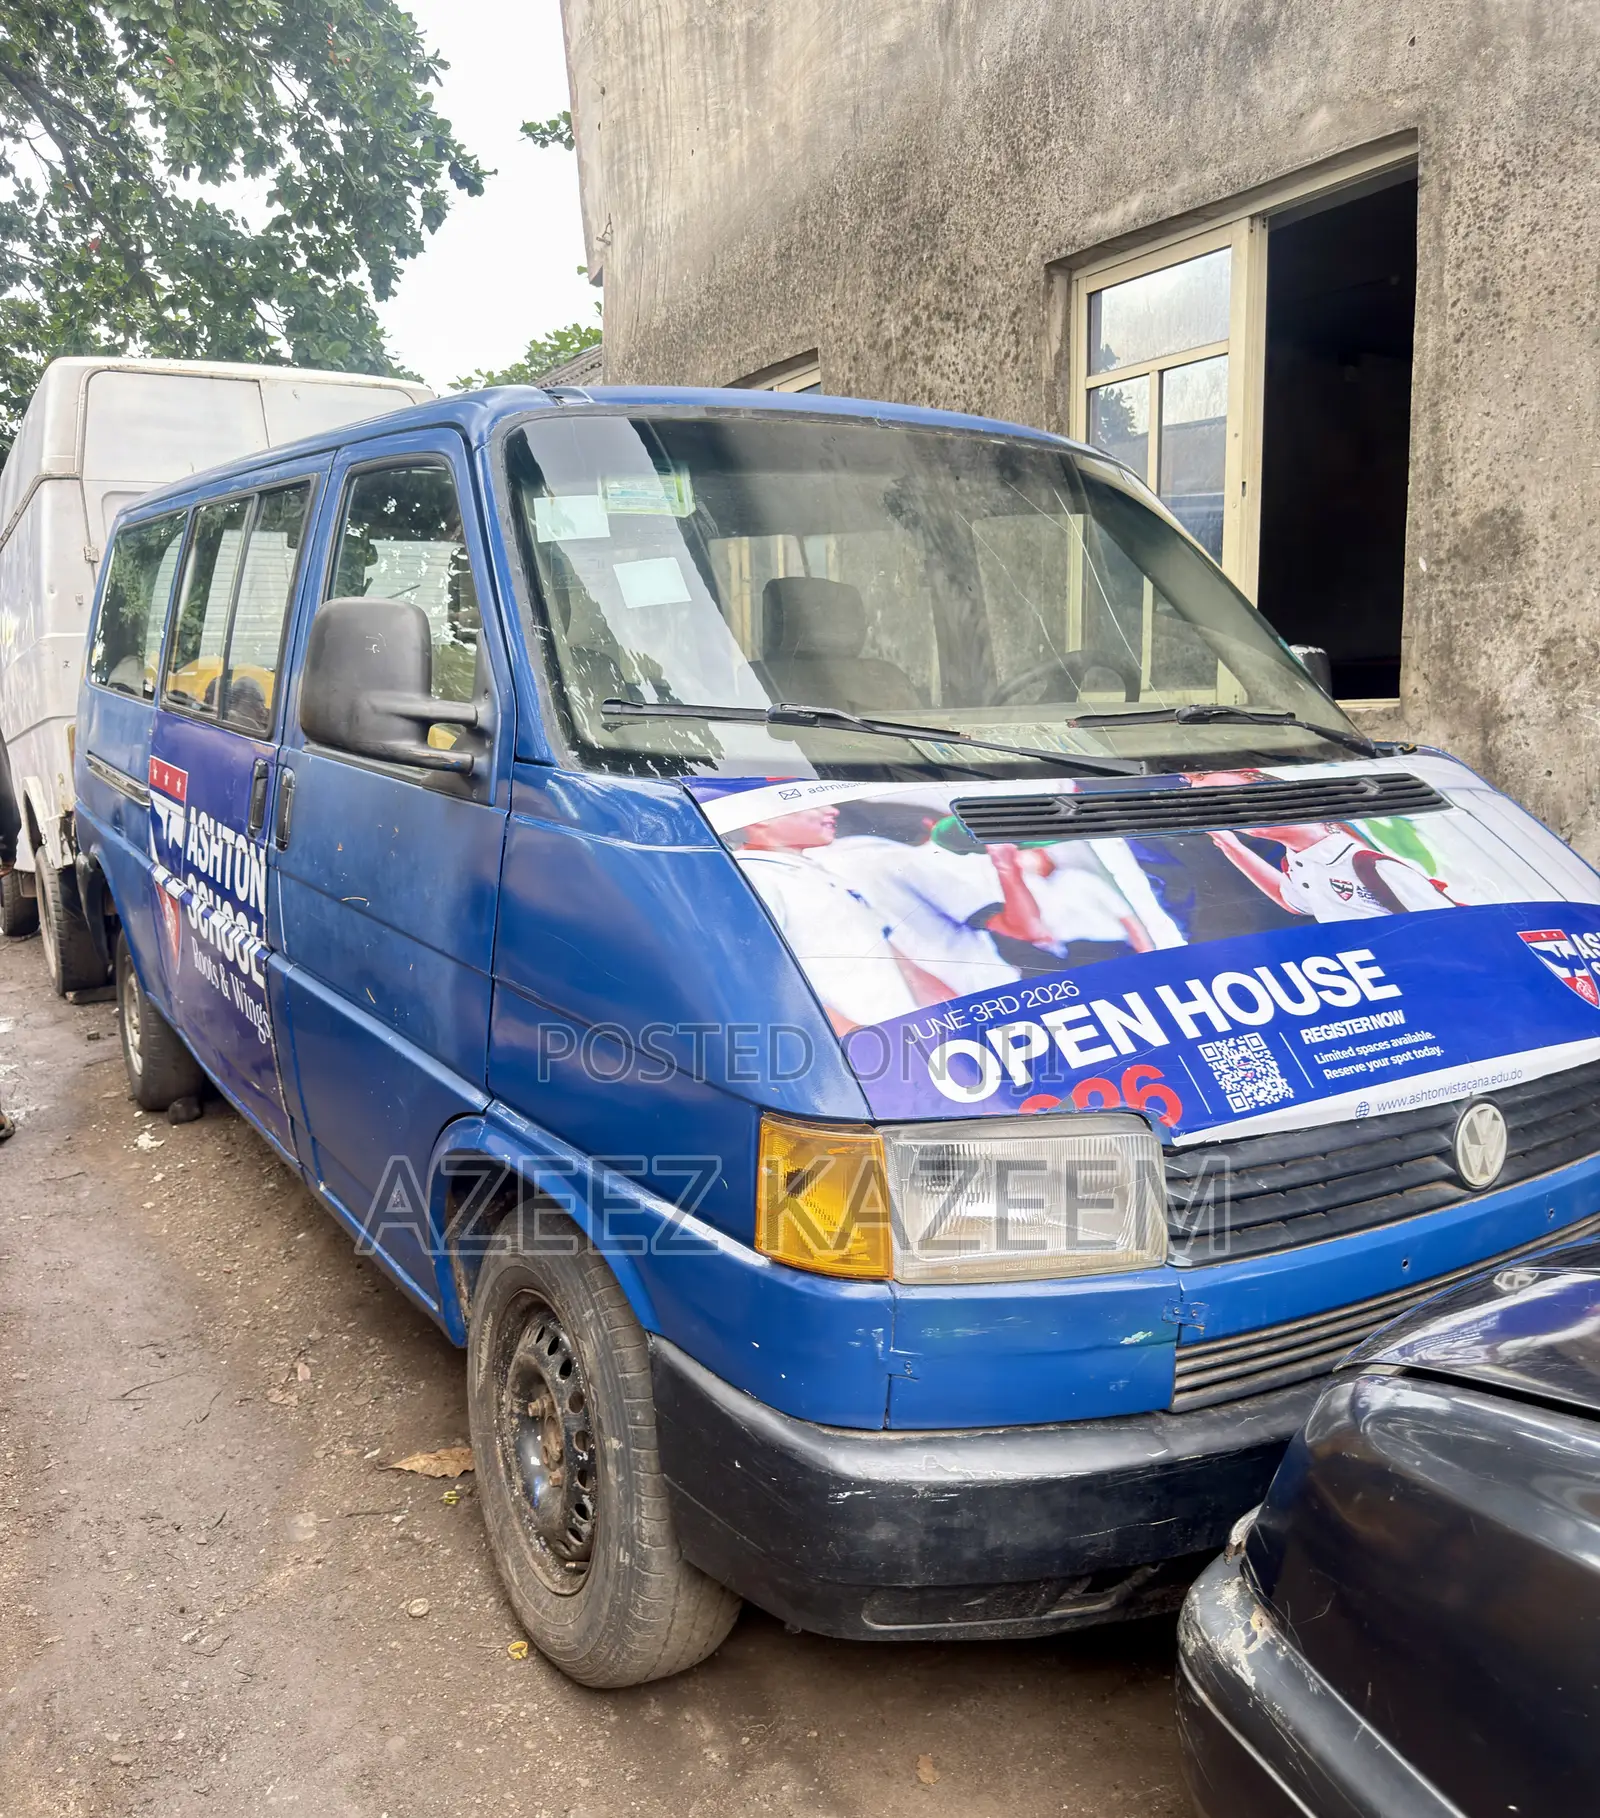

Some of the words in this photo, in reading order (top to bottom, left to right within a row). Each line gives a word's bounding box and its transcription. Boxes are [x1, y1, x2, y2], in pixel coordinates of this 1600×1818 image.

[807, 782, 873, 794] admiss
[186, 806, 267, 916] ASHTON
[187, 873, 266, 989] SCHOOL
[1570, 932, 1600, 959] AS
[191, 936, 219, 989] Roots
[219, 963, 231, 1001] &
[230, 971, 272, 1045] Wings
[905, 1009, 971, 1044] JUNE
[969, 995, 1020, 1022] 3RD
[1020, 980, 1080, 1008] 2026
[928, 991, 1170, 1103] OPEN
[1154, 949, 1403, 1039] HOUSE
[1314, 1047, 1356, 1064] Limited
[1356, 1041, 1391, 1056] spaces
[1390, 1031, 1436, 1047] available.
[1323, 1064, 1367, 1080] Reserve
[1366, 1058, 1389, 1072] your
[1391, 1051, 1414, 1065] spot
[1412, 1046, 1445, 1058] today.
[1377, 1068, 1523, 1112] www.ashtonvistacana.edu.do
